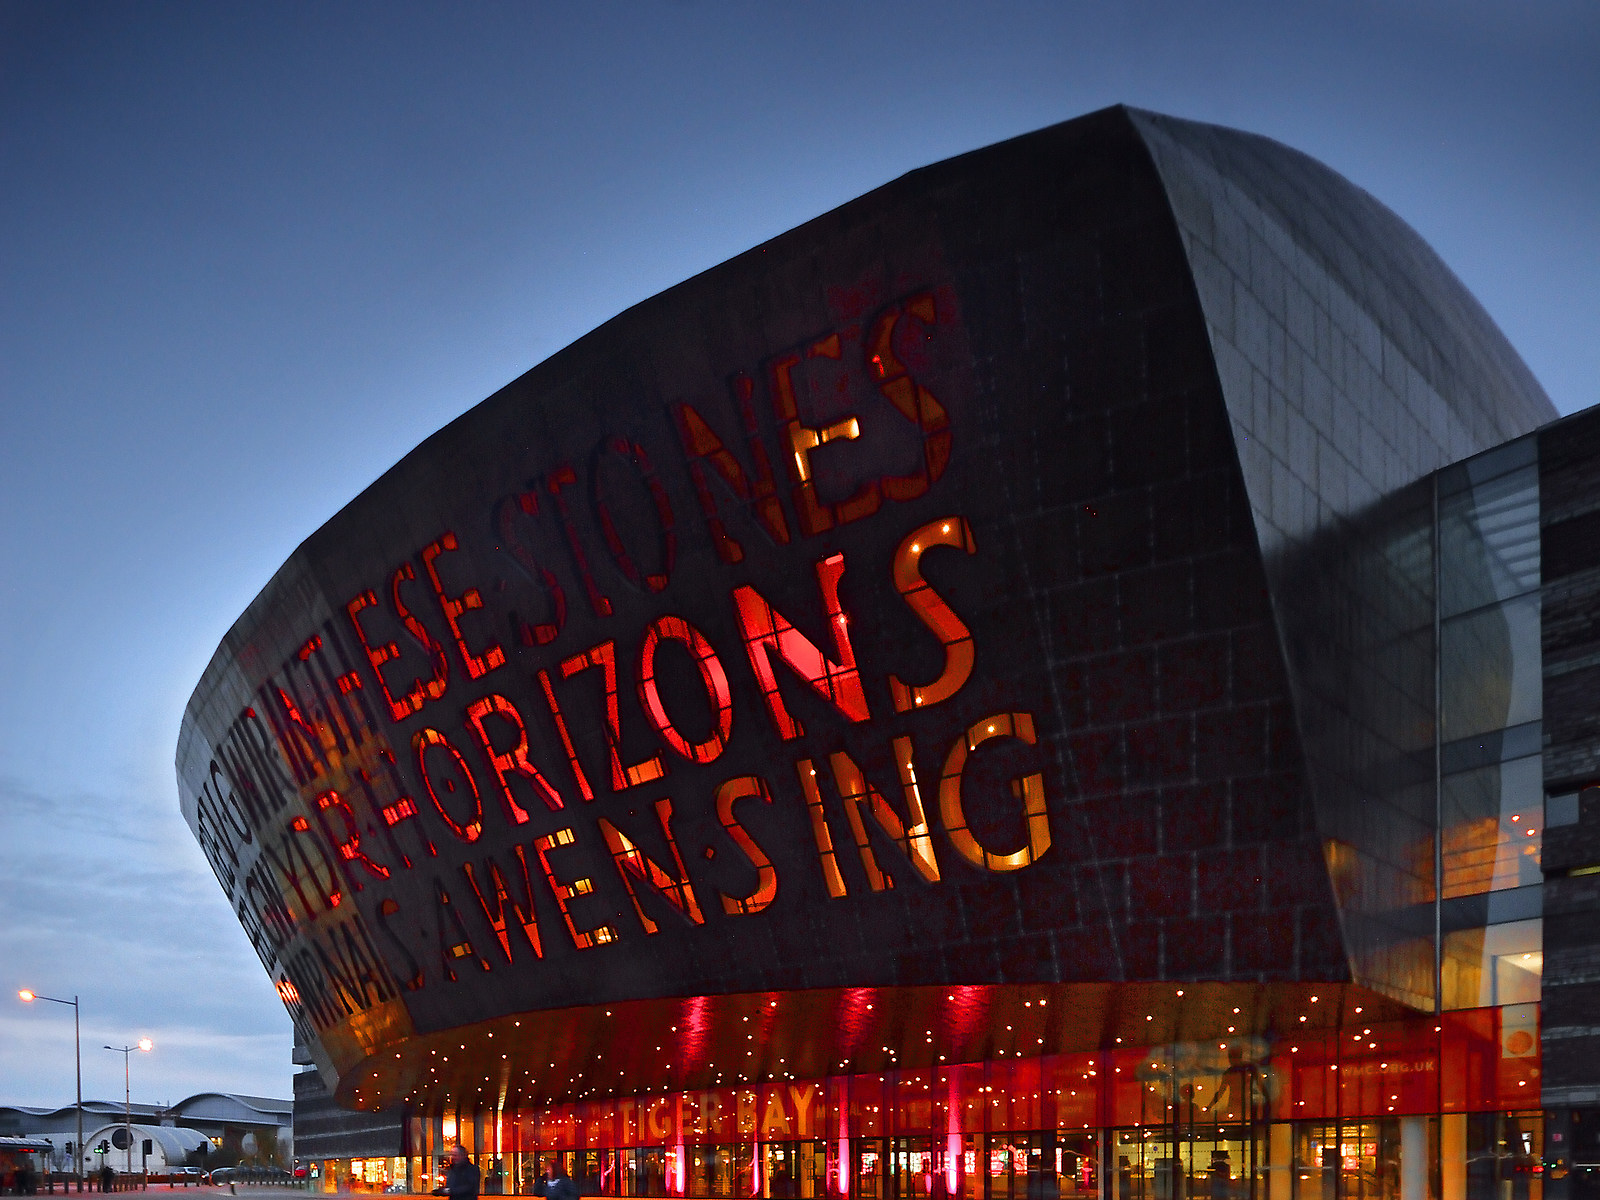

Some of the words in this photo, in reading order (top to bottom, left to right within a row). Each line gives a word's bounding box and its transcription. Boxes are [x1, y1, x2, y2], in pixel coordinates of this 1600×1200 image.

[492, 296, 956, 648] STONES
[355, 515, 977, 870] HORIZONS
[440, 798, 706, 983] AWEN
[714, 712, 1053, 916] SING
[617, 1093, 723, 1145] TIGER
[736, 1084, 816, 1137] BAY
